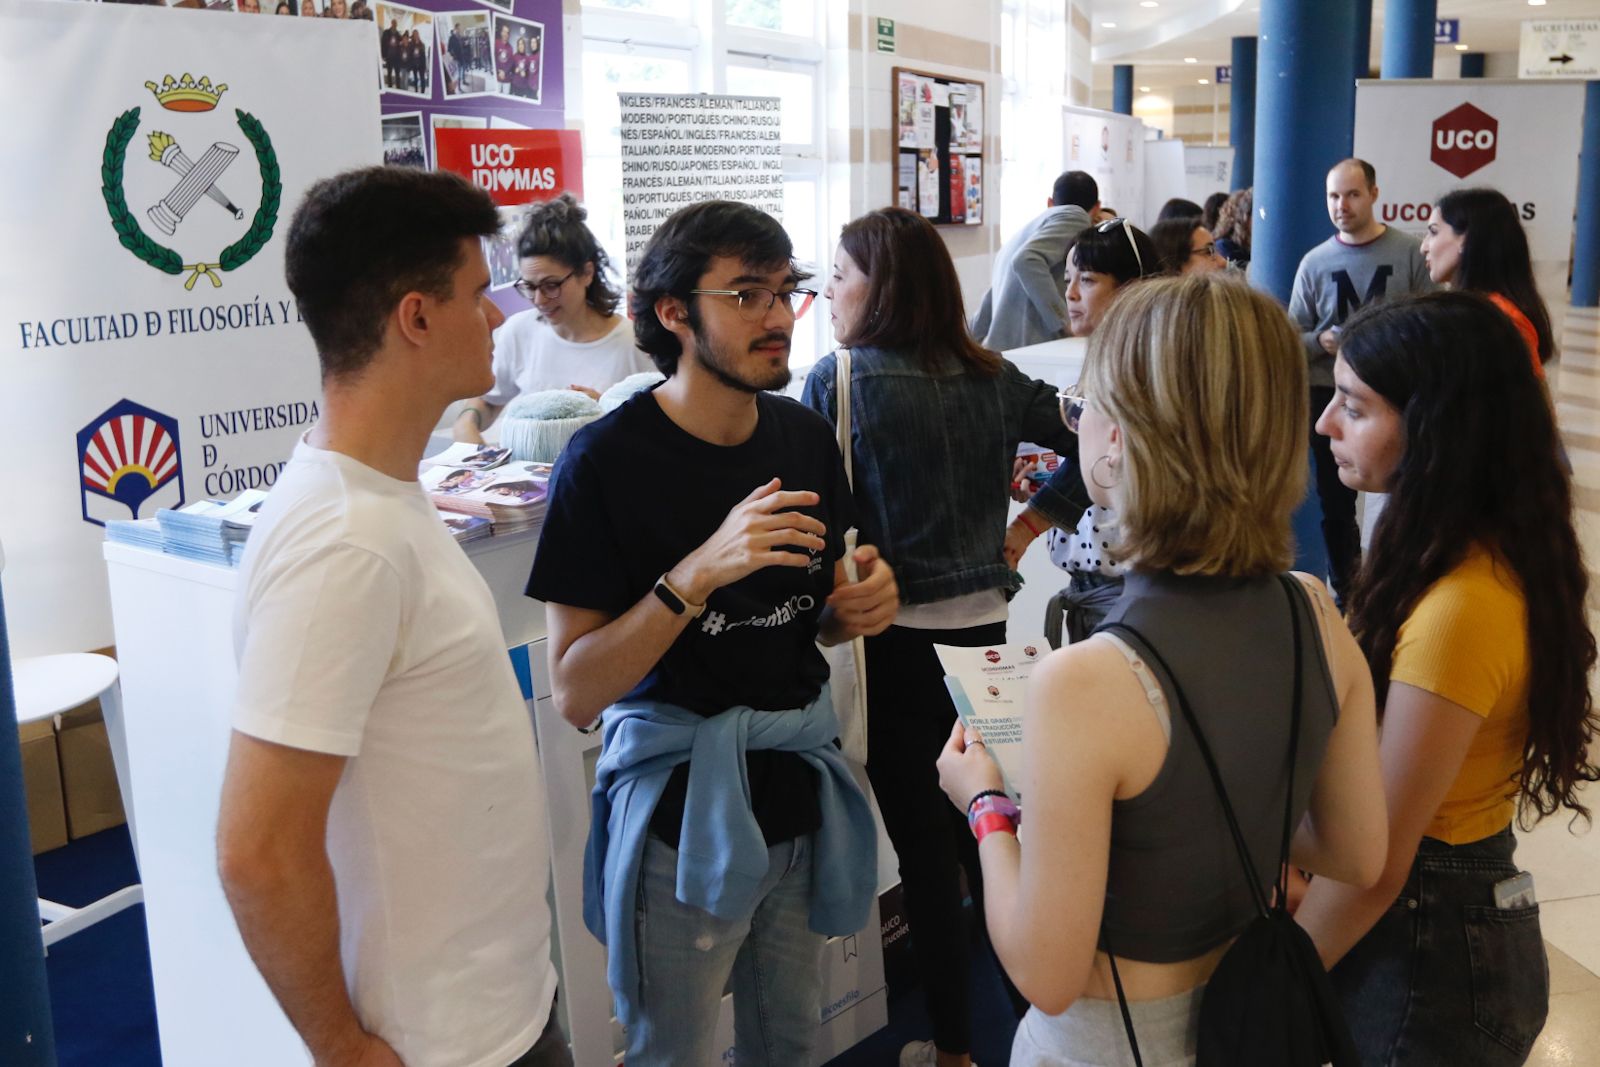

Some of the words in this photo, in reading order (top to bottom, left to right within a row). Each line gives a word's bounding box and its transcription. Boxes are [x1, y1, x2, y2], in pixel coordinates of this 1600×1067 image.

[471, 143, 515, 167] UCO
[1436, 129, 1494, 150] UCO
[1331, 265, 1393, 323] M
[19, 312, 138, 349] FACULTAD
[167, 295, 275, 334] FILOSOFÍA
[279, 299, 293, 323] Y
[199, 400, 320, 439] UNIVERSIDA
